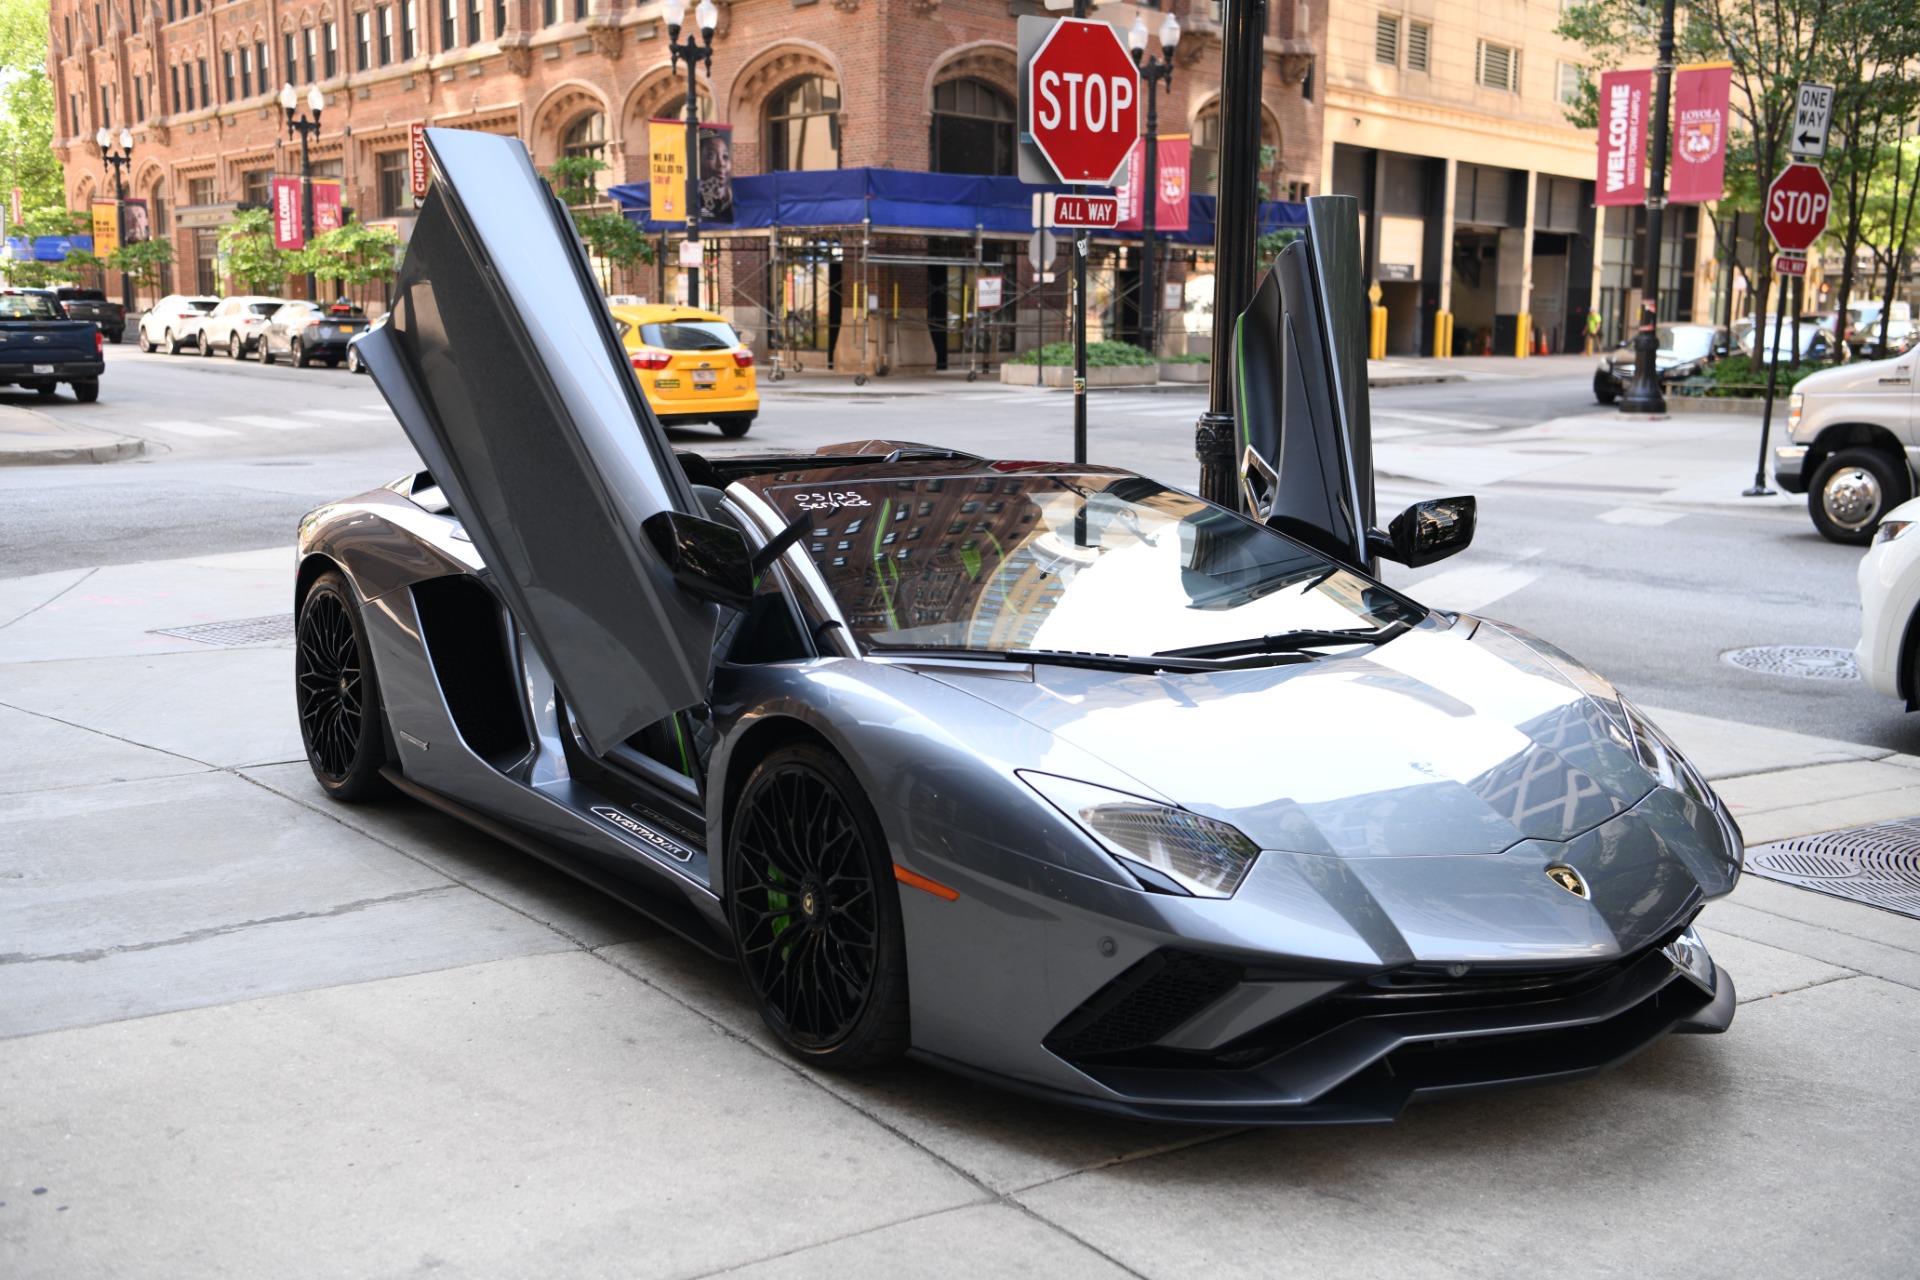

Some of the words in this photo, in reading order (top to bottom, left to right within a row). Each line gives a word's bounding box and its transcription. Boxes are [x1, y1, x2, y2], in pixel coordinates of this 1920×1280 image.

[1038, 70, 1133, 133] STOP
[1801, 90, 1828, 109] ONE
[1681, 109, 1721, 120] LOYOLA
[1798, 109, 1825, 128] WAY
[1606, 84, 1630, 193] WELCOME
[412, 125, 426, 193] CHIPOTLE
[278, 185, 292, 243] WELCOME
[1059, 202, 1084, 220] ALL
[1088, 203, 1113, 222] WAY
[1770, 189, 1827, 225] STOP
[1778, 259, 1790, 271] ALL
[1791, 261, 1806, 273] WAY
[794, 491, 862, 502] 05/25
[604, 811, 684, 855] AVENTADOR
